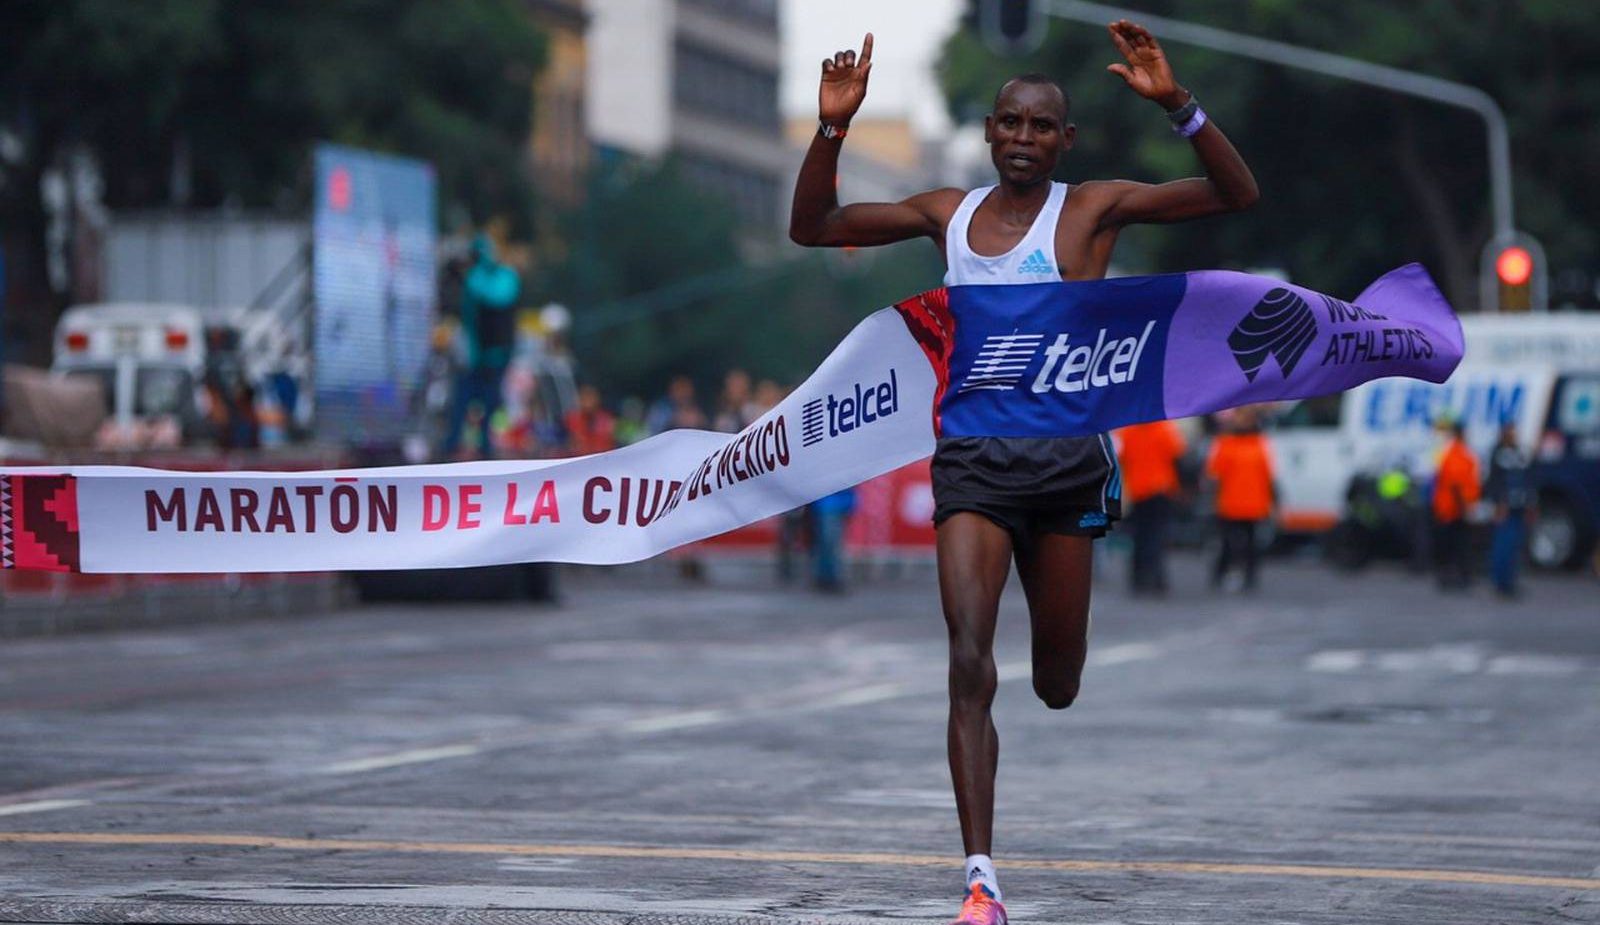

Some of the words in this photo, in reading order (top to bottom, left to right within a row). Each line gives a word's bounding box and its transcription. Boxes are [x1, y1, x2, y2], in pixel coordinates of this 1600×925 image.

[1017, 261, 1054, 274] adidas
[1318, 294, 1388, 323] WOR
[1031, 320, 1156, 394] telcel
[827, 368, 898, 438] telcel
[421, 484, 482, 531] DE
[503, 480, 560, 526] LA
[687, 450, 720, 502] DE
